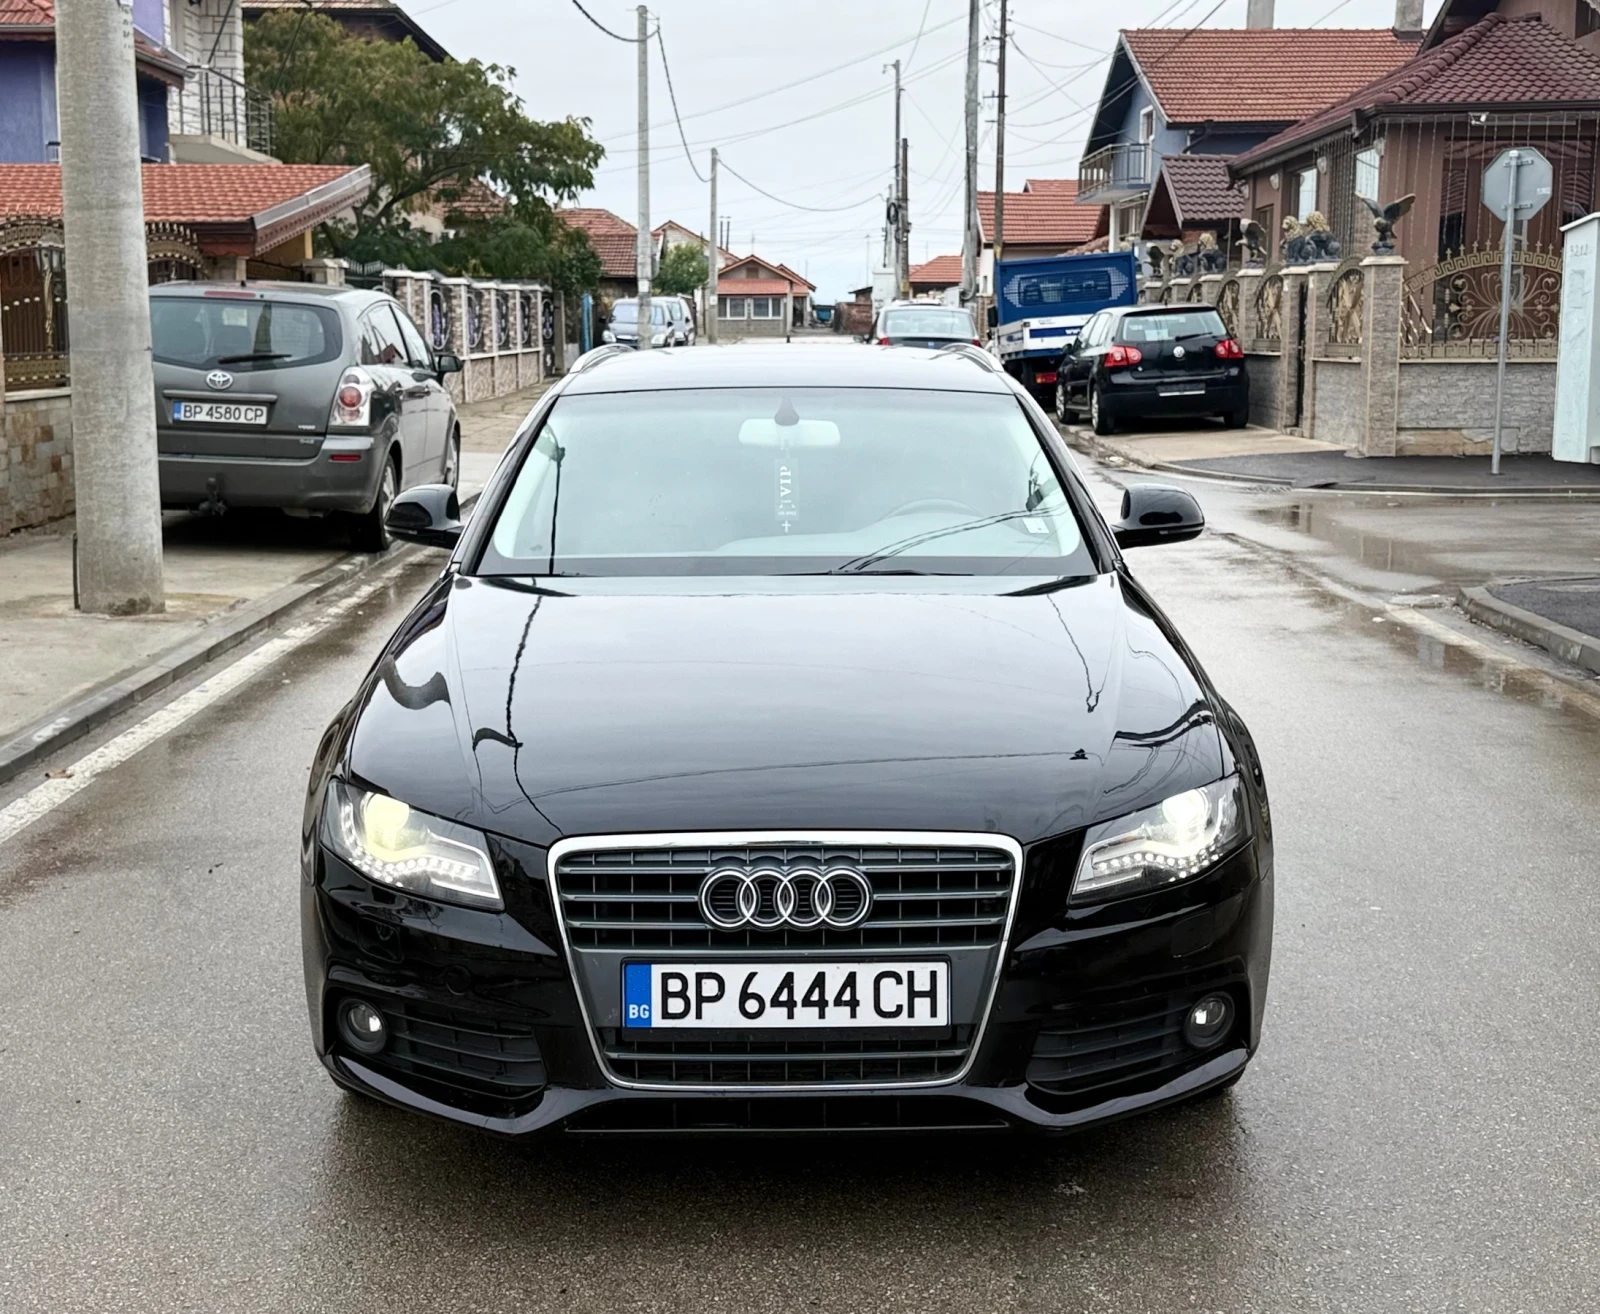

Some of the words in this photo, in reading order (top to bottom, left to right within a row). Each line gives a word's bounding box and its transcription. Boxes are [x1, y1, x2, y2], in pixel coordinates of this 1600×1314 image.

[183, 404, 203, 419] BP
[206, 405, 242, 420] 4580
[244, 407, 264, 422] CP
[780, 465, 792, 498] VIP
[661, 971, 726, 1020] BP
[738, 971, 860, 1020] 6444
[873, 970, 938, 1019] CH
[628, 1004, 650, 1019] BG
